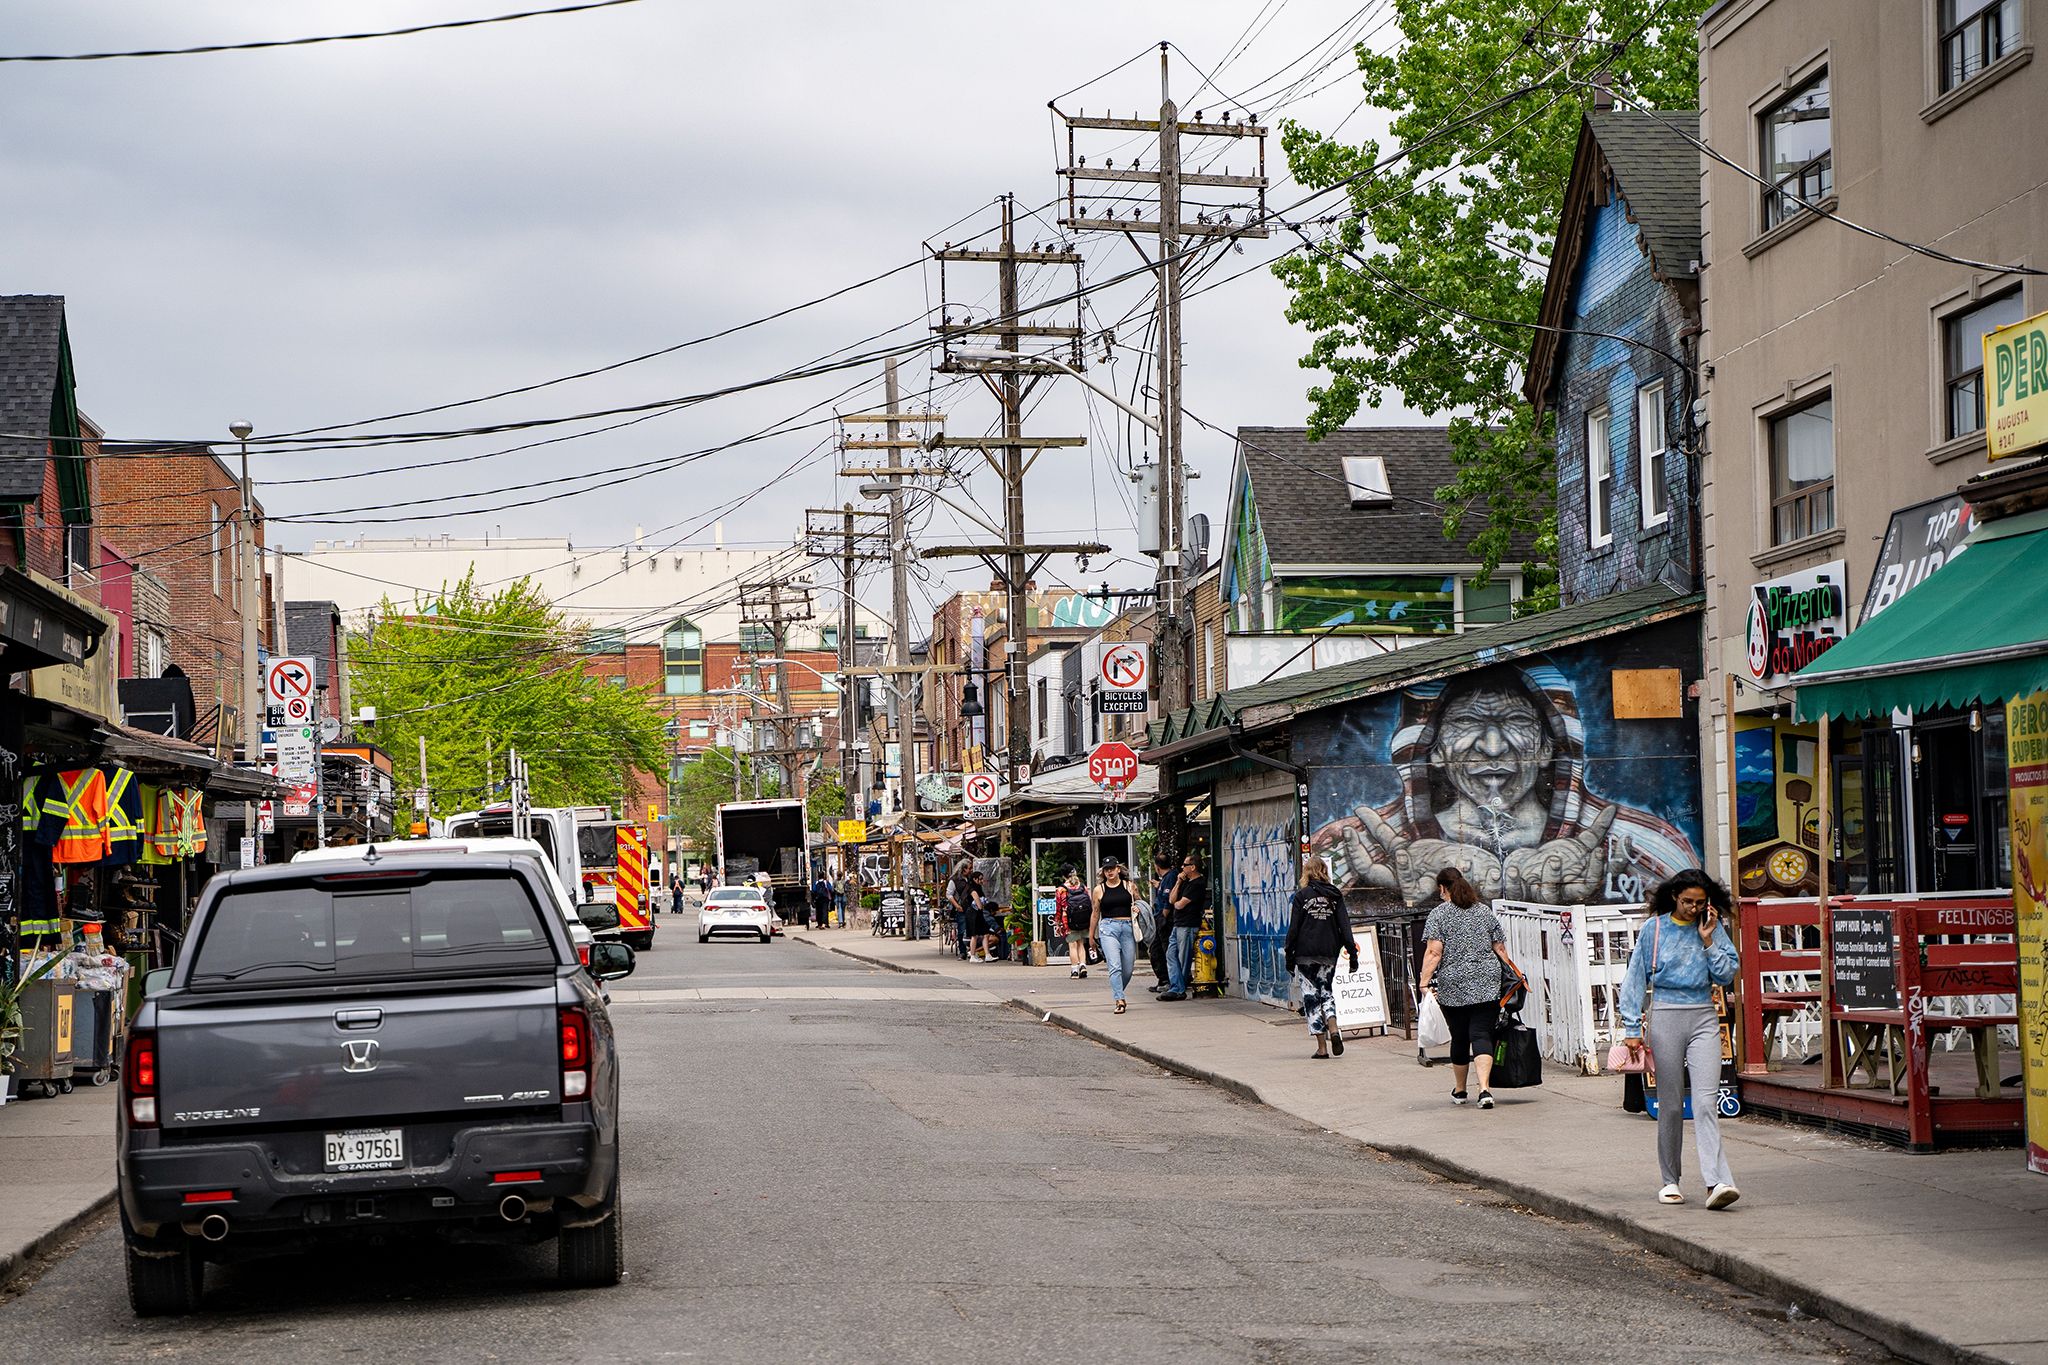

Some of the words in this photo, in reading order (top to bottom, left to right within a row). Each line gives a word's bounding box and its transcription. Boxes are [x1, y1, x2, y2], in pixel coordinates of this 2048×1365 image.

[1997, 409, 2030, 432] AUGUSTA
[1998, 432, 2016, 450] #247
[1926, 508, 1960, 546] TOP
[1769, 575, 1833, 632] Pizzeria
[1772, 638, 1791, 675] da
[1104, 691, 1142, 701] BICYCLES
[1103, 702, 1144, 712] EXCEPTED
[1091, 757, 1135, 777] STOP
[2015, 770, 2042, 783] PRODUCTOS
[1835, 920, 1848, 932] HAPPY
[1848, 920, 1860, 932] HOUR
[1835, 942, 1849, 952] Chicken
[1864, 942, 1874, 955] Wrap
[1878, 942, 1887, 953] Beef
[1846, 955, 1856, 969] Wrap
[1335, 972, 1373, 985] SLICES
[1836, 970, 1846, 980] bottle
[1850, 971, 1861, 981] water
[1341, 988, 1373, 1000] PIZZA
[508, 1090, 550, 1100] AWD
[174, 1107, 261, 1122] RIDGELINE
[327, 1142, 346, 1162] BX
[356, 1138, 401, 1160] 97561
[348, 1162, 393, 1171] ZANCHIN
